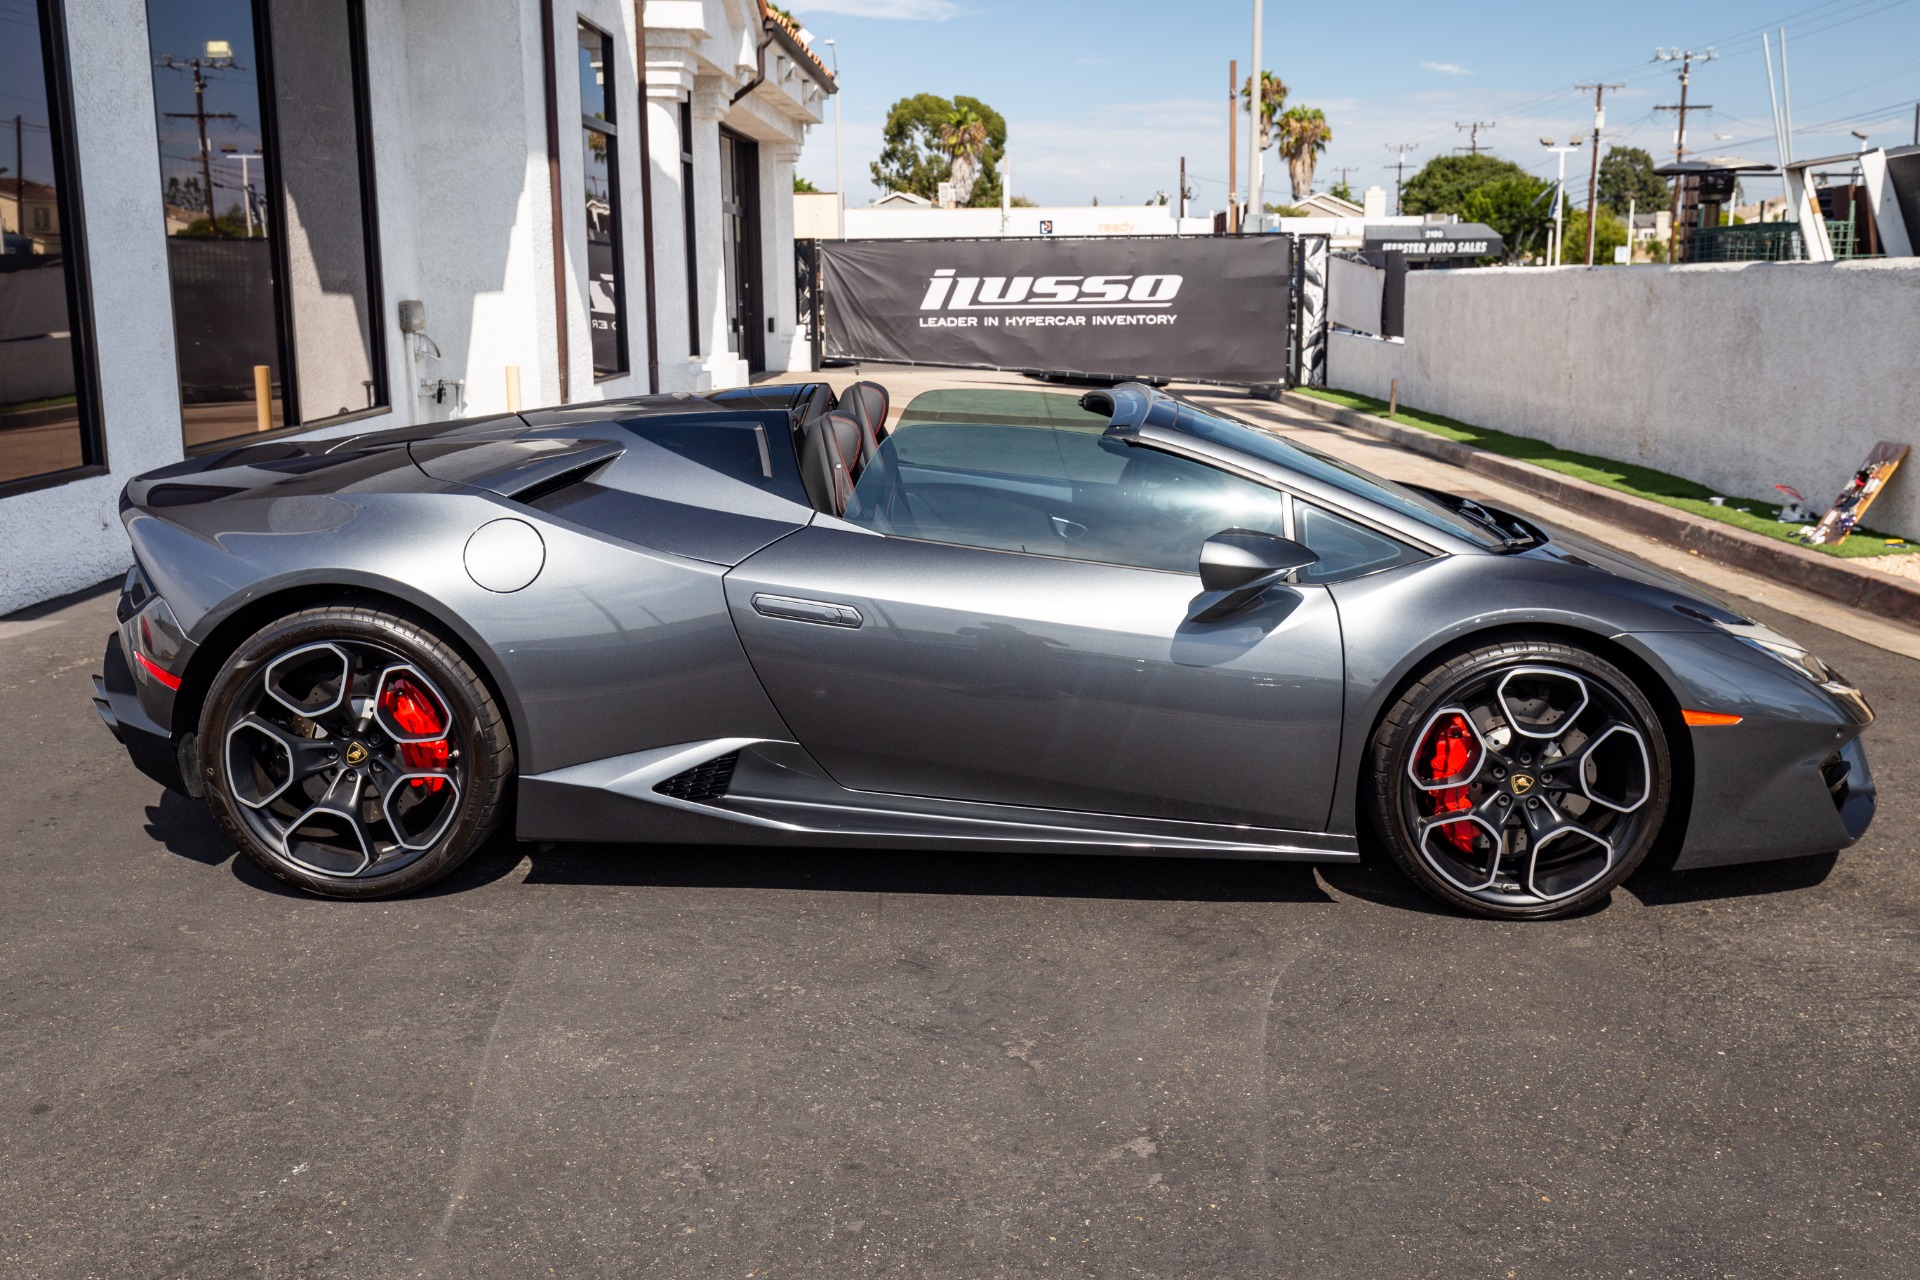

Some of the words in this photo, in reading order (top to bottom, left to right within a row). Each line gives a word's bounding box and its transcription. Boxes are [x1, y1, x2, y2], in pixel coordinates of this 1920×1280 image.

[1427, 242, 1456, 254] AUTO
[1457, 241, 1488, 253] SALES
[919, 316, 978, 328] LEADER
[984, 316, 999, 327] IN
[1005, 315, 1087, 327] HYPERCAR
[1092, 314, 1178, 326] INVENTORY
